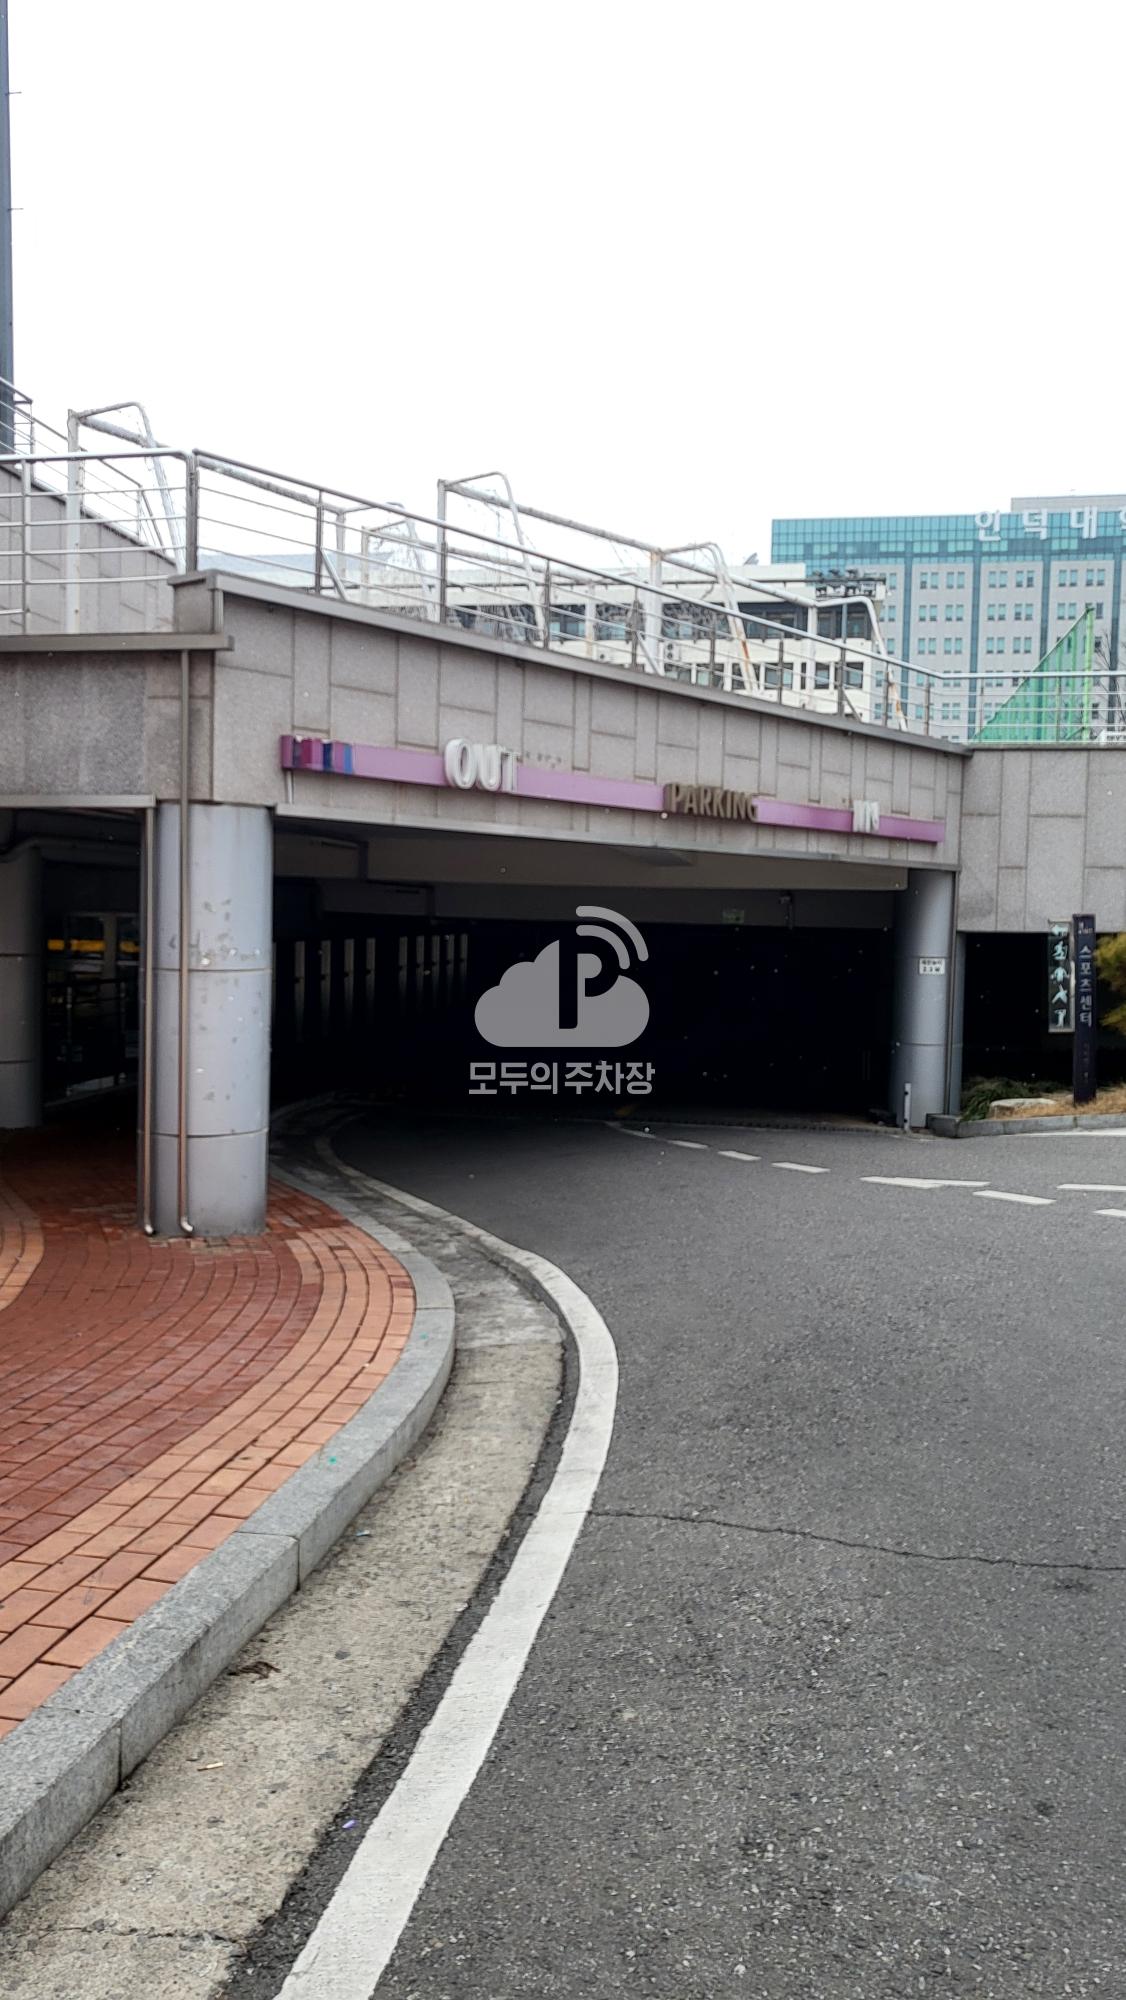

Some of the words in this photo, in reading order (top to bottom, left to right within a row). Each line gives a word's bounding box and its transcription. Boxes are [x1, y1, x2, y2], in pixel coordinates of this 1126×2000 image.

[445, 738, 520, 792] OUT
[666, 784, 758, 822] PARKING
[852, 799, 880, 833] IN
[1079, 945, 1093, 1028] 스포츠센터
